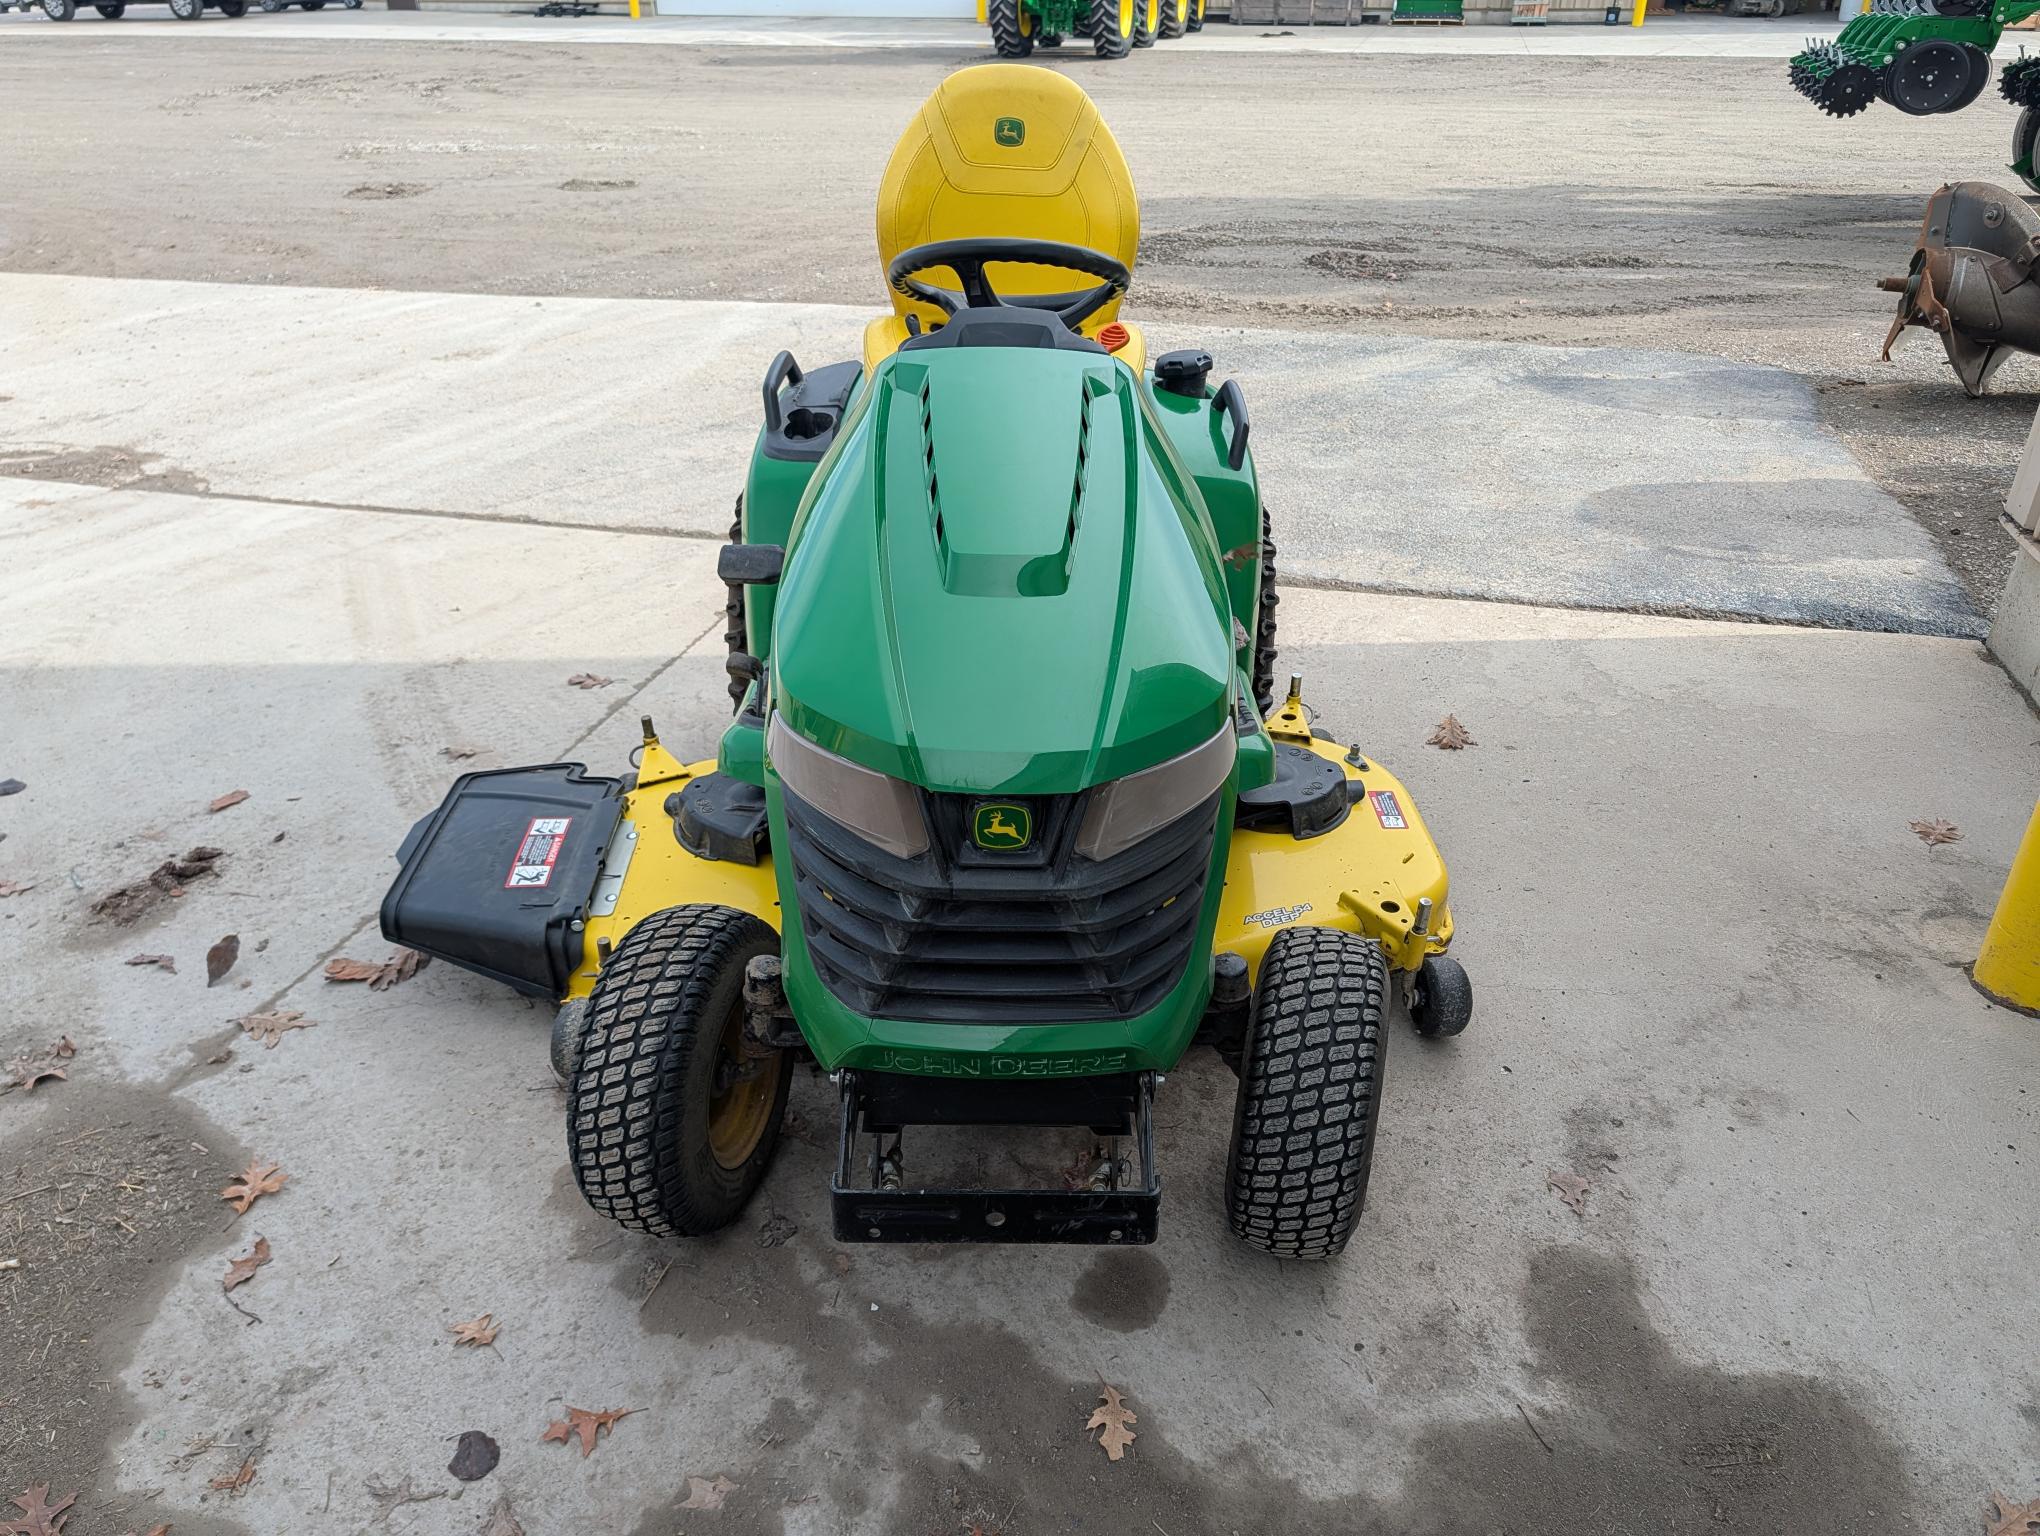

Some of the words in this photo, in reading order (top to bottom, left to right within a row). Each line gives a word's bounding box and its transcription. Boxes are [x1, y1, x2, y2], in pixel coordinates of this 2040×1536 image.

[1244, 907, 1292, 925] ACCEL
[1292, 903, 1313, 914] 54
[1261, 912, 1301, 928] DEEP
[873, 1050, 981, 1075] JOHN
[991, 1052, 1127, 1075] DEERE
